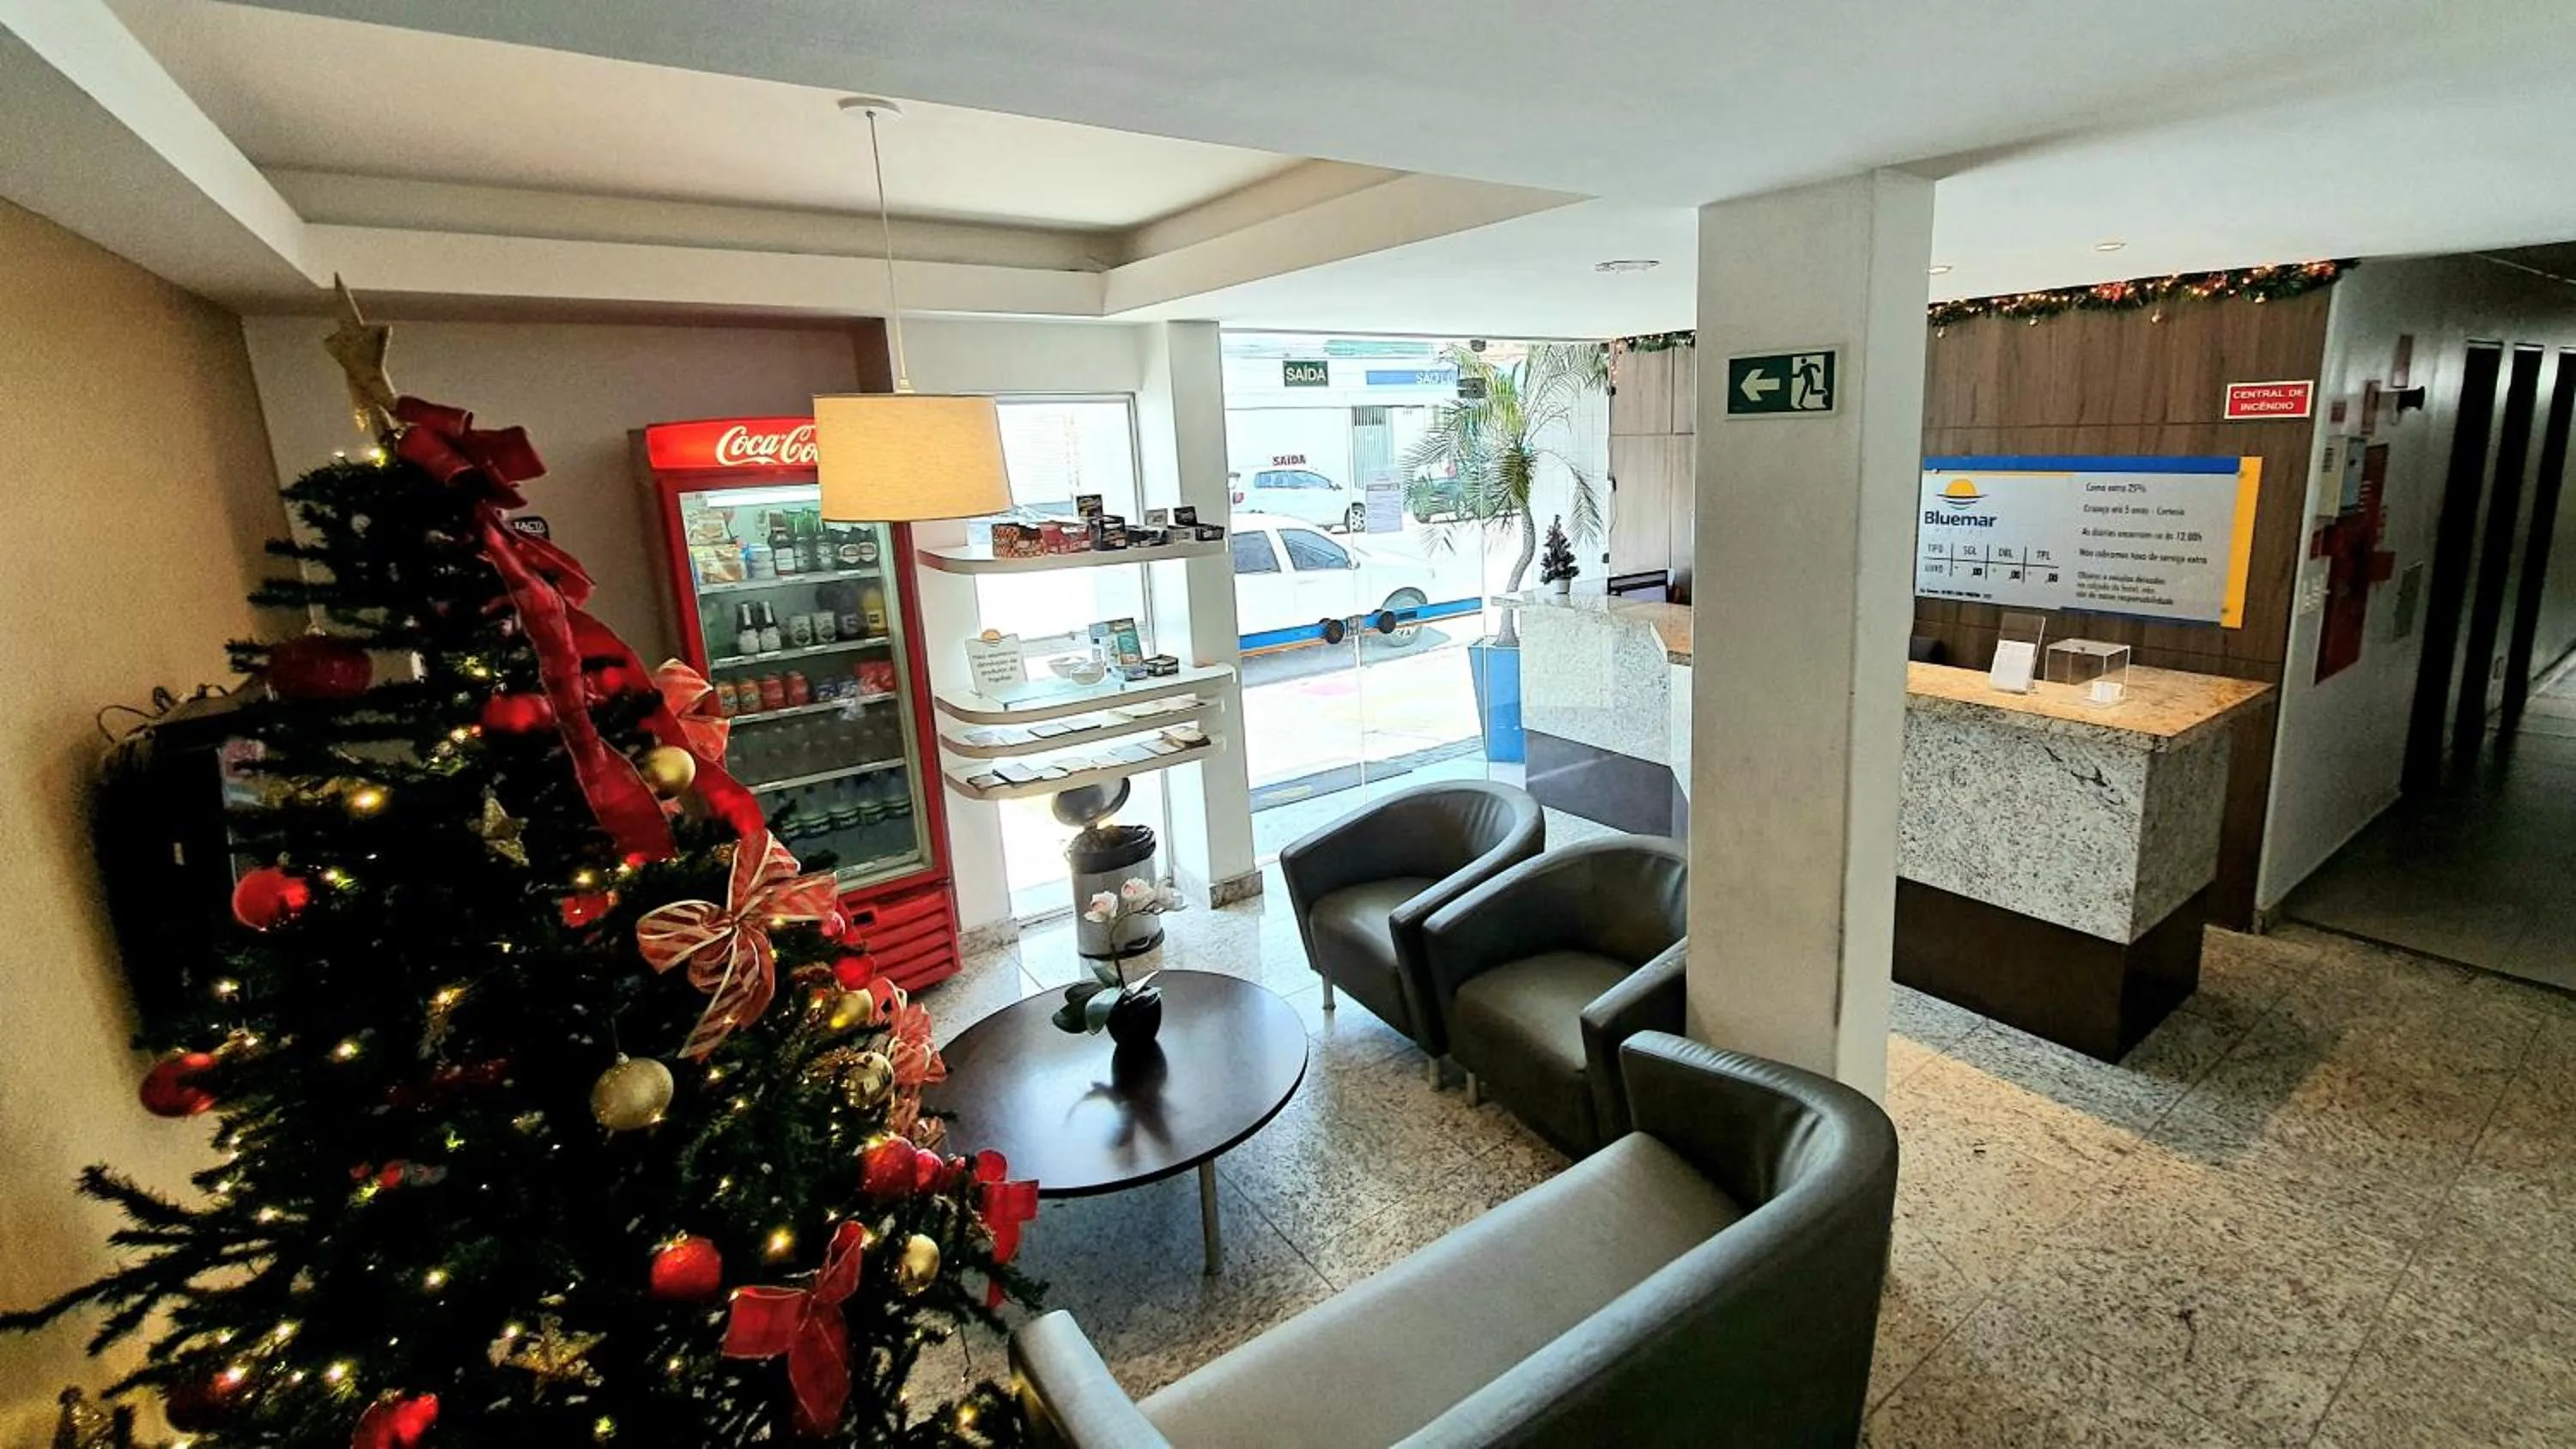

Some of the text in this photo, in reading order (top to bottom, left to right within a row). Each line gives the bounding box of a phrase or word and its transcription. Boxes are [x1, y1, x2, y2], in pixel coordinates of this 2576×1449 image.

[1286, 364, 1326, 381] SAÍDA
[2233, 388, 2306, 399] CENTRAL DE
[2240, 401, 2294, 411] INCÊNDIO
[715, 425, 819, 465] Coca-Co
[1924, 510, 1997, 528] Bluemar
